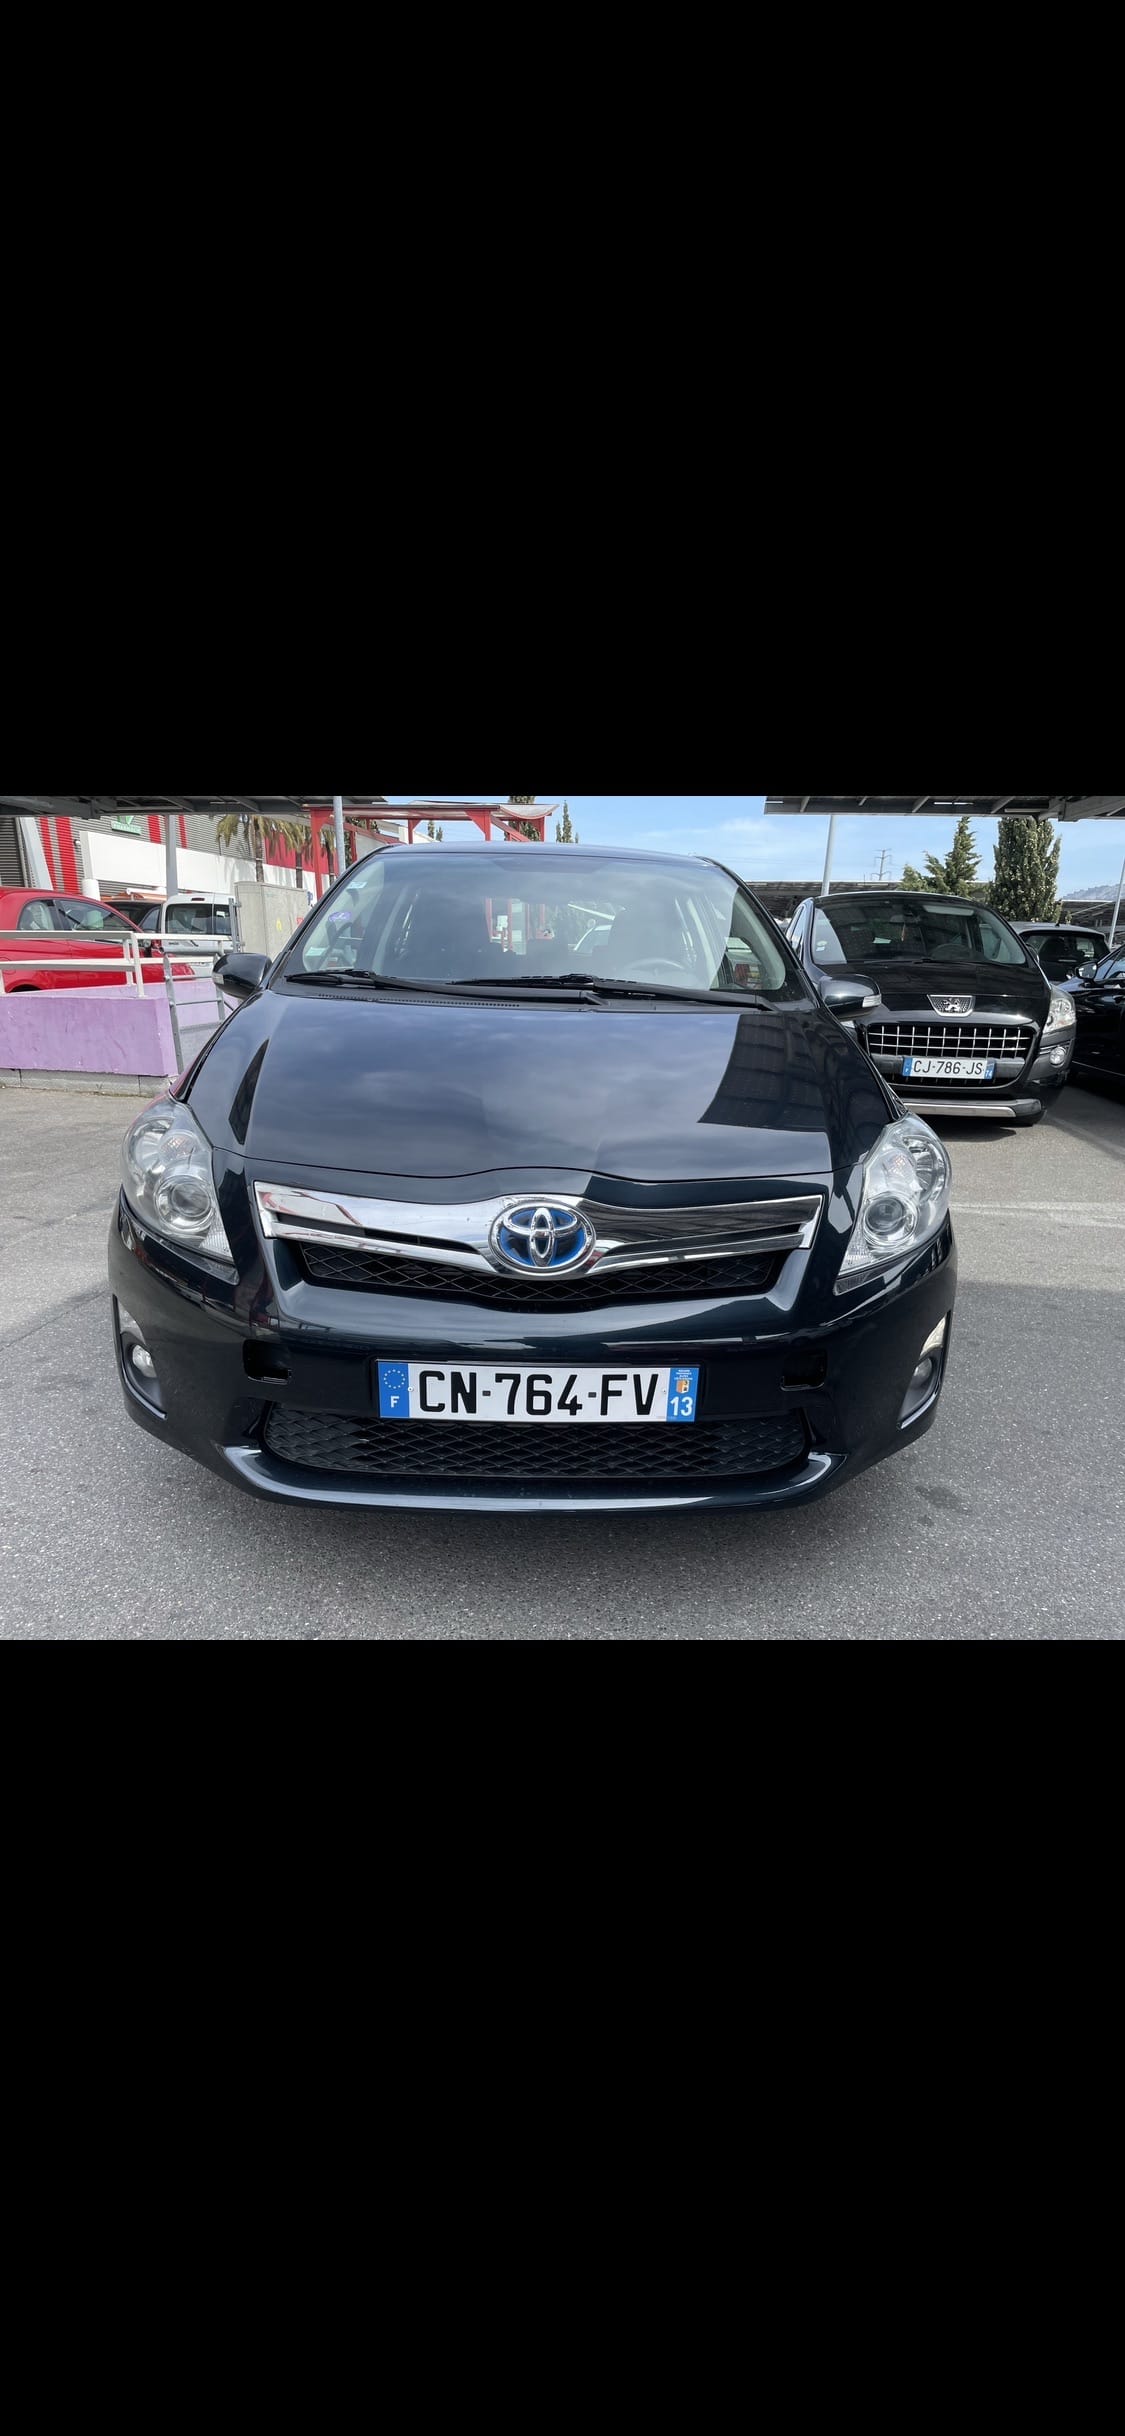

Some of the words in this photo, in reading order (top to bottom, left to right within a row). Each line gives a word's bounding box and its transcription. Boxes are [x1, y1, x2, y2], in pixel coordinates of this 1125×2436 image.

[913, 1060, 983, 1075] CJ-786-JS
[390, 1395, 399, 1408] F
[418, 1370, 659, 1416] CN-764-FV
[670, 1396, 693, 1416] 13
